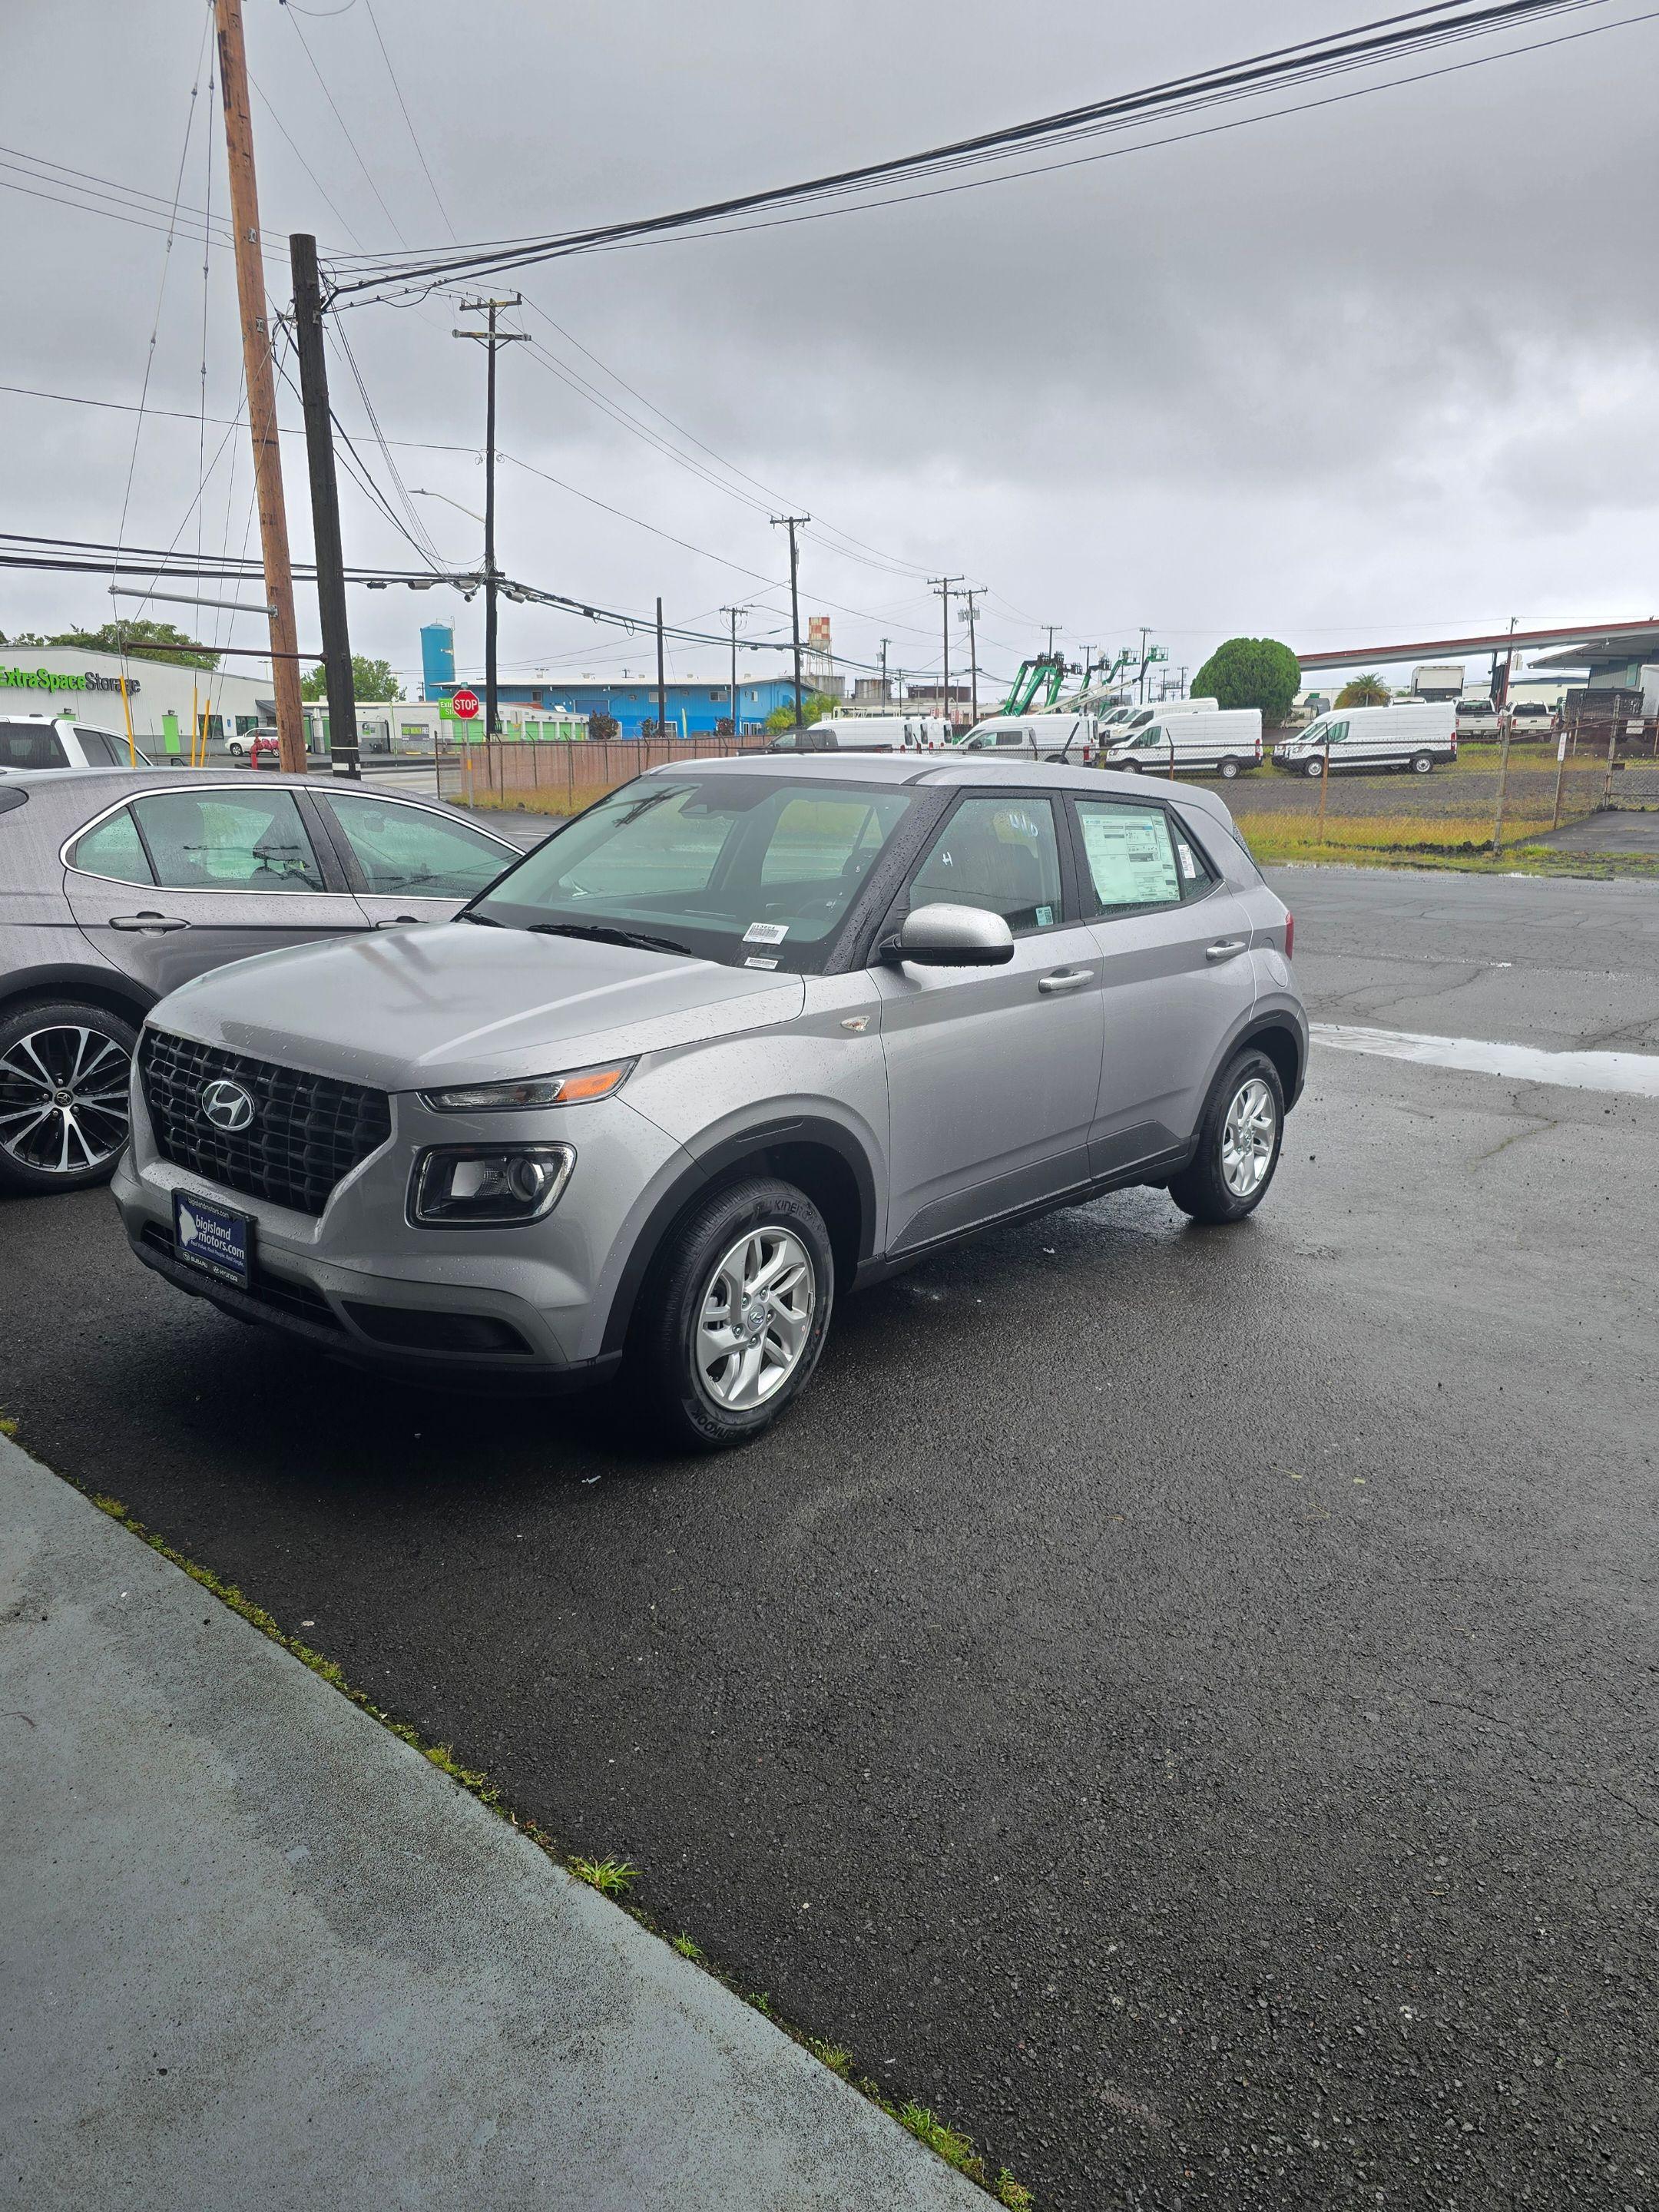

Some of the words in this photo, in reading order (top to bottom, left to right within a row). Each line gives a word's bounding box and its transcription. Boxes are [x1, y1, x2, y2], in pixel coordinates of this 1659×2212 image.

[454, 699, 478, 710] STOP
[196, 1214, 231, 1241] bigisland
[198, 1231, 245, 1260] motors.com
[190, 1256, 208, 1269] SUBARU
[220, 1270, 238, 1283] HYUNDAI
